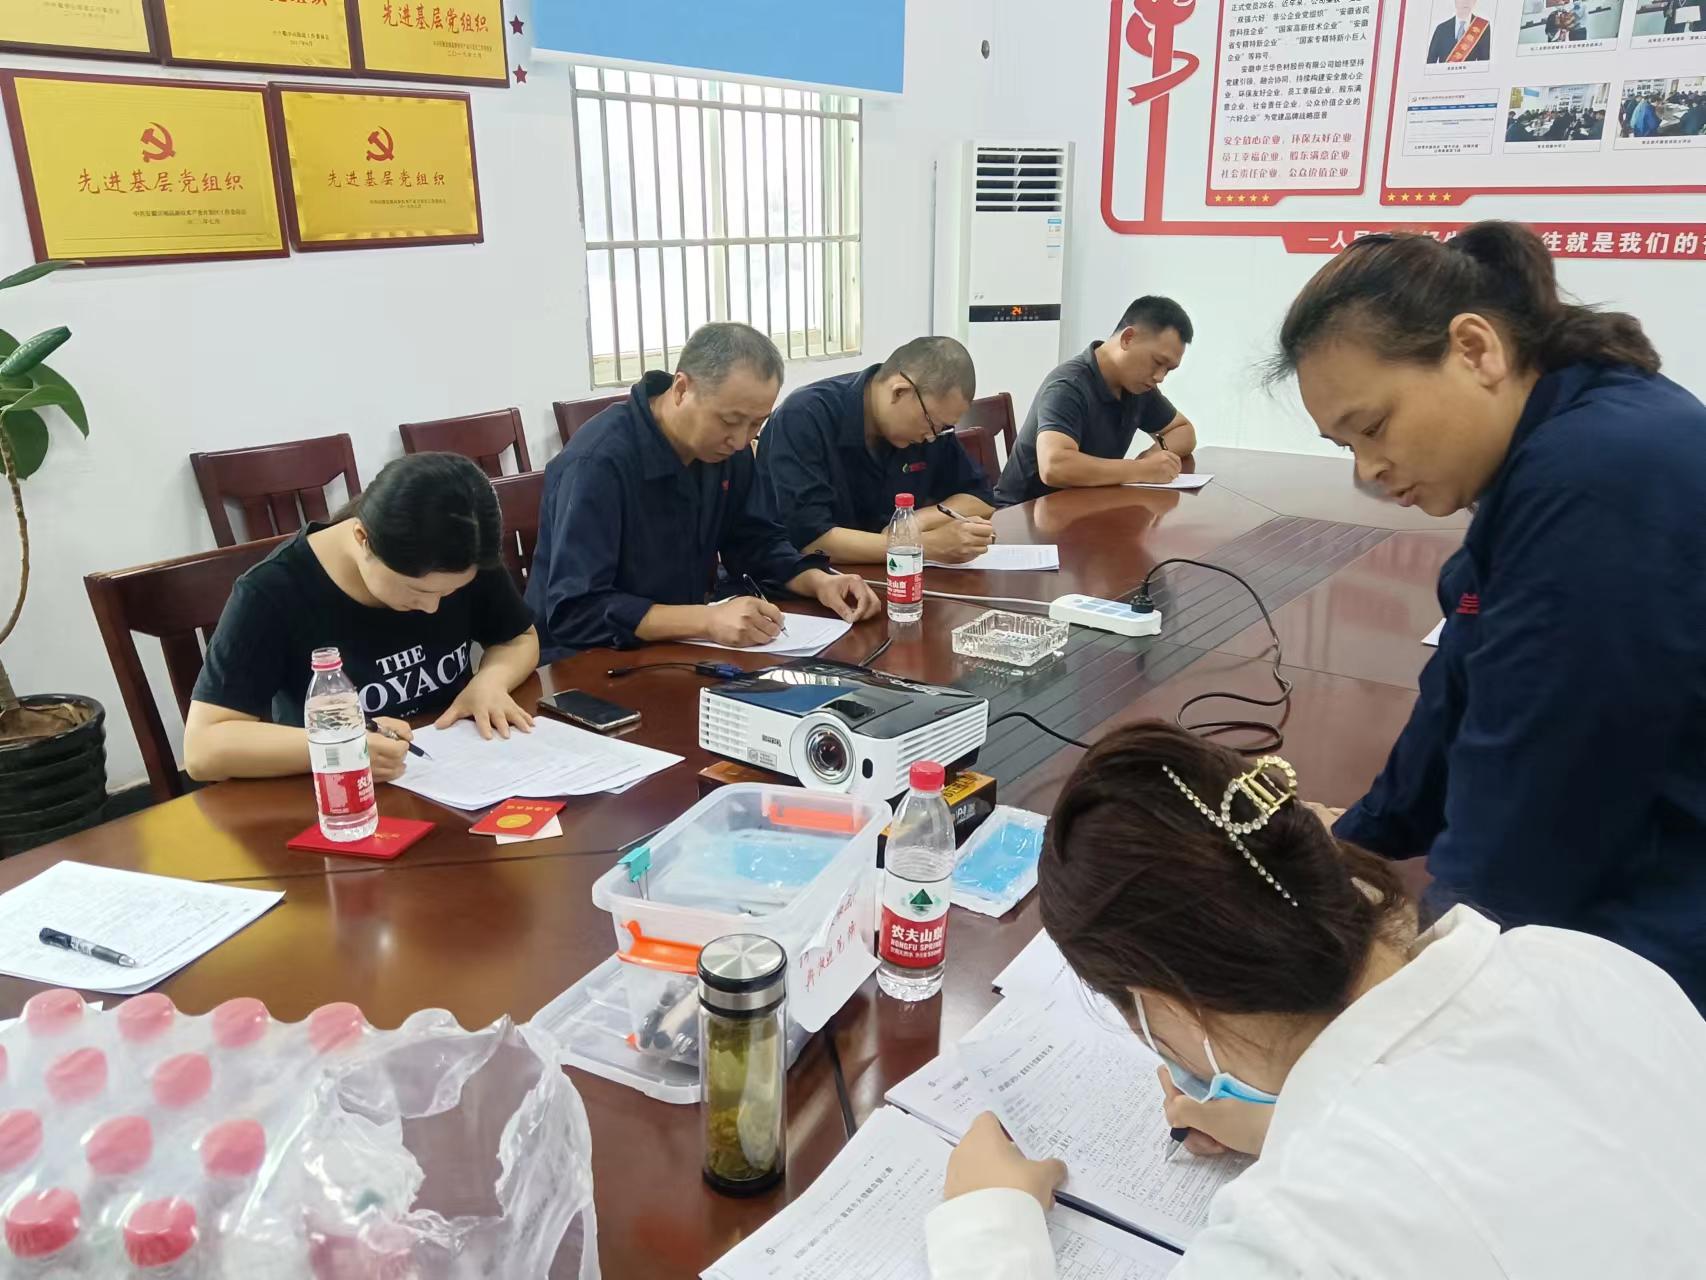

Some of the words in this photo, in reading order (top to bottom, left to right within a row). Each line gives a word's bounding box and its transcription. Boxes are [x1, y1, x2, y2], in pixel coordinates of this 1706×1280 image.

[381, 0, 489, 34] 先进基层党组织
[78, 168, 245, 194] 先进基层党组织
[327, 168, 446, 188] 先进基层党组织
[1541, 231, 1706, 255] 往就是我们的
[376, 645, 426, 676] THE
[890, 937, 918, 952] NONGFU
[891, 924, 944, 943] 农夫山泉
